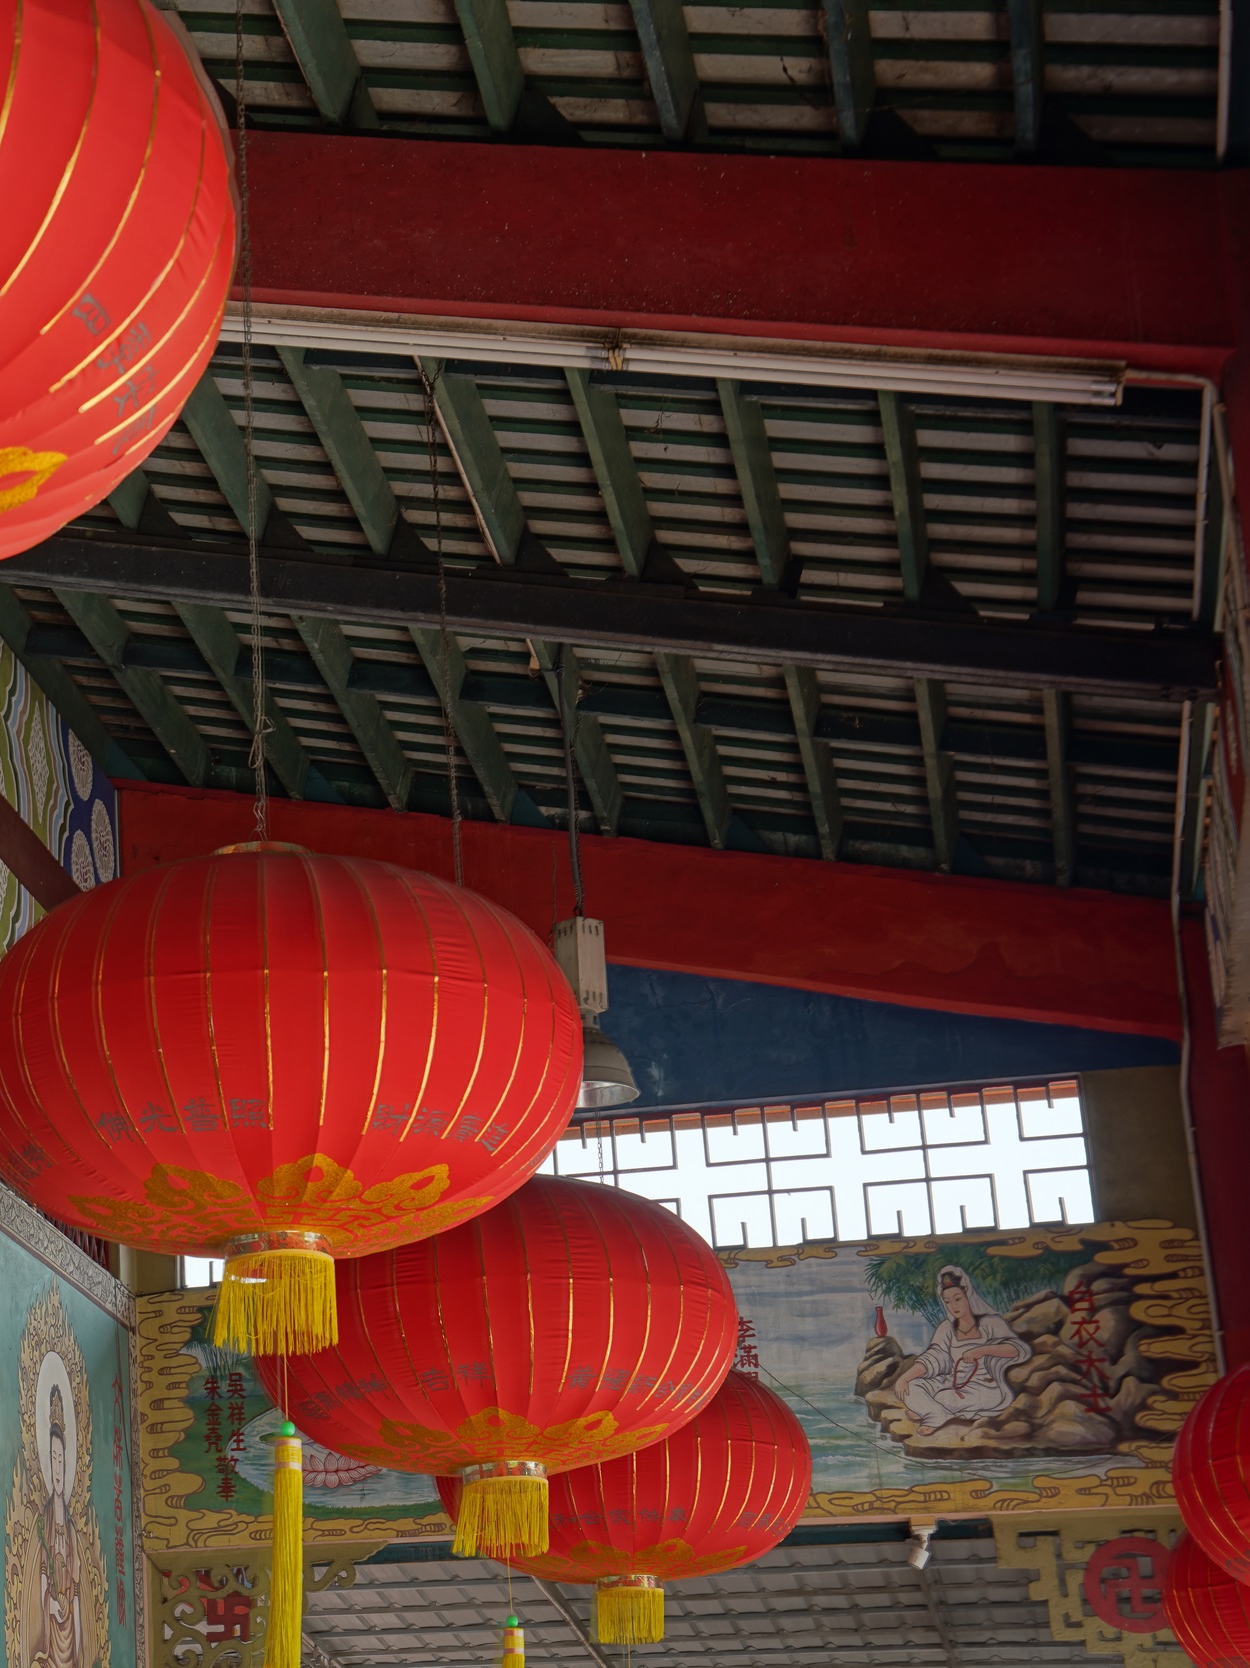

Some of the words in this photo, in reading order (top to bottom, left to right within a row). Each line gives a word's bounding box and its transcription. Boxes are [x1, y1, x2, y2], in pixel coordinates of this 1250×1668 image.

[96, 1097, 268, 1144] 佛光普照
[370, 1104, 509, 1152] 財源廣進
[1067, 1280, 1112, 1414] 白衣大士
[421, 1362, 492, 1392] 吉祥
[226, 1372, 247, 1452] 吳祥生
[215, 1455, 239, 1502] 敬奉
